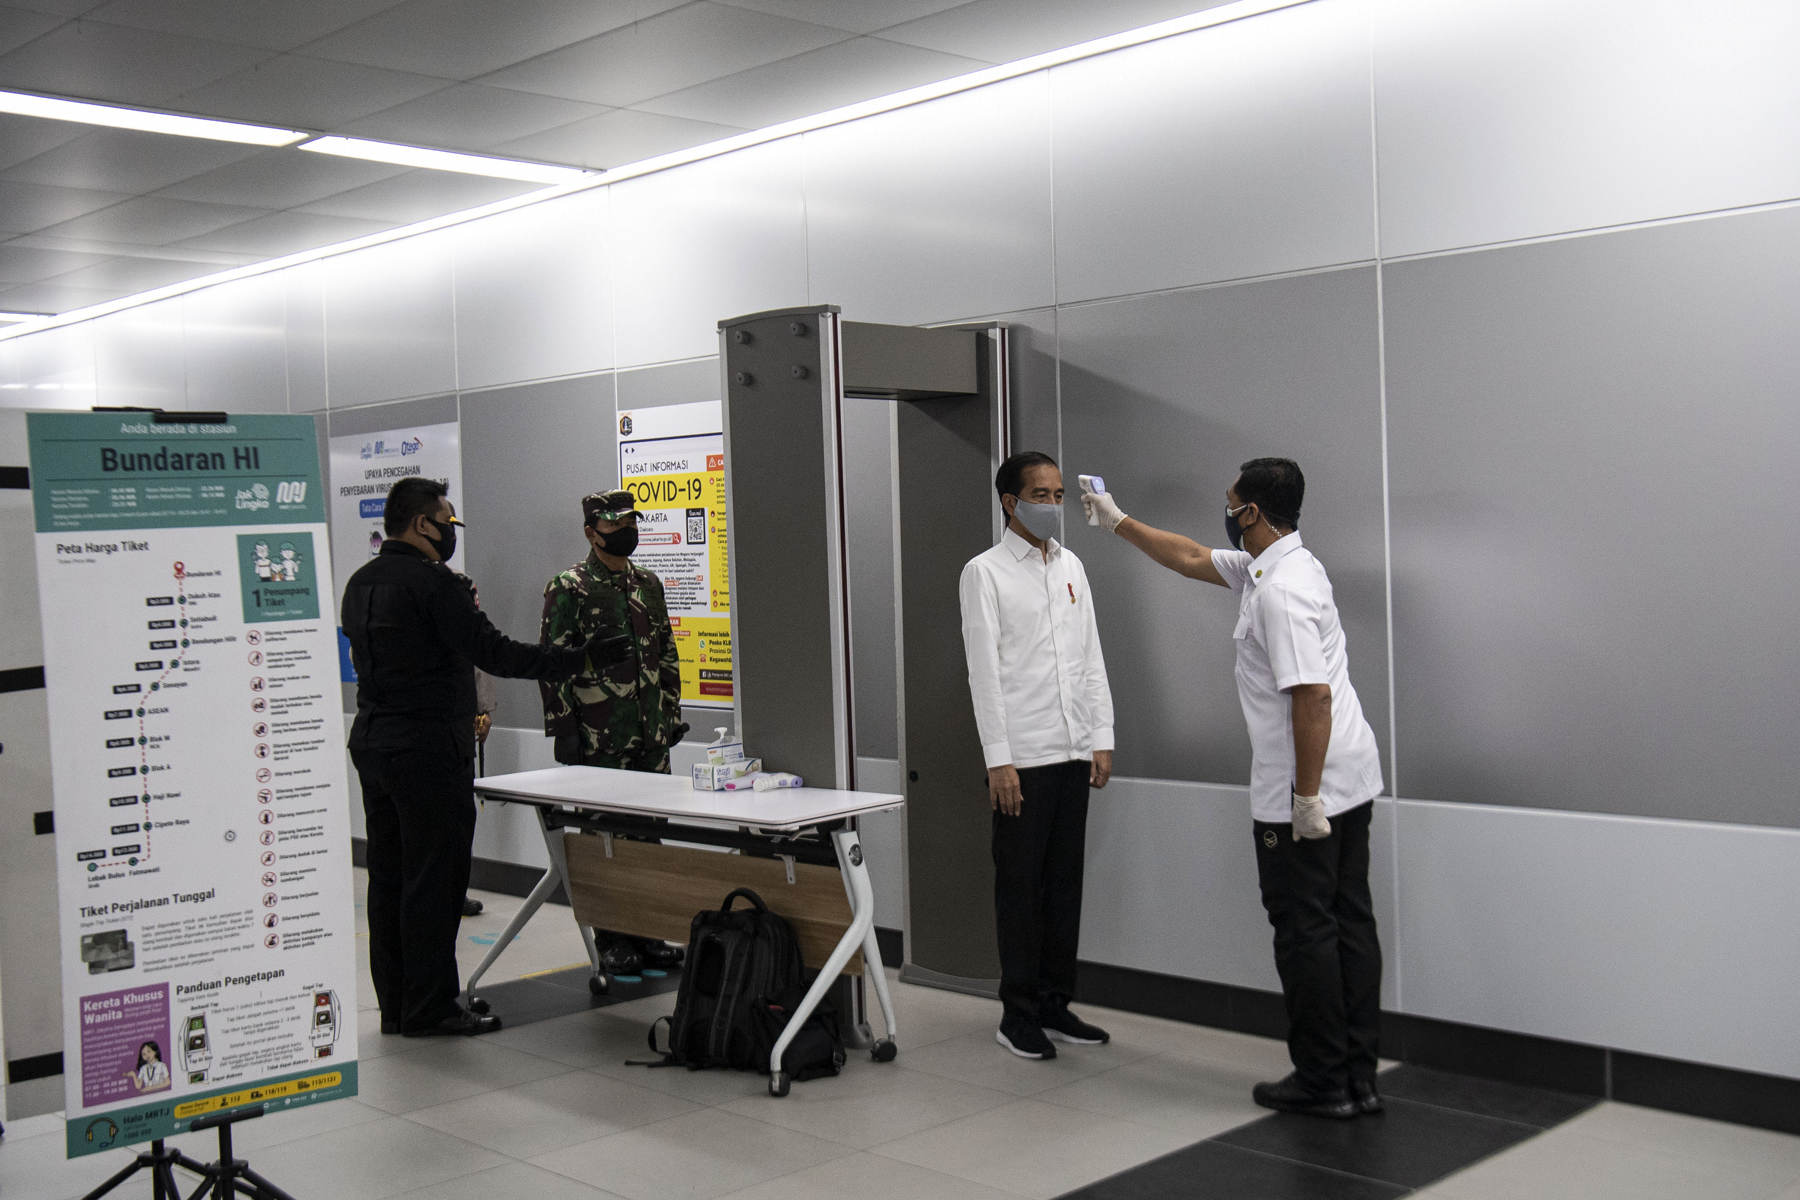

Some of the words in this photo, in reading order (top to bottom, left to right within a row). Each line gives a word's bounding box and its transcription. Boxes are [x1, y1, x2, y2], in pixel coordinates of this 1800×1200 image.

[120, 423, 148, 434] Anda
[150, 424, 186, 434] berada
[188, 424, 198, 434] di
[200, 425, 238, 434] stasiun
[101, 446, 226, 472] Bundaran
[232, 446, 260, 470] HI
[626, 463, 648, 474] PUSAT
[650, 460, 688, 472] INFORMASI
[364, 469, 383, 480] UPAYA
[383, 466, 421, 478] PENCEGAHAN
[340, 484, 376, 496] PENYEBARAN
[376, 482, 392, 493] VIRUS
[626, 478, 702, 502] COVID-19
[56, 543, 82, 554] Peta
[85, 542, 118, 554] Harga
[120, 540, 150, 552] Tiket
[252, 588, 262, 608] 1
[80, 905, 109, 918] Tiket
[112, 897, 170, 913] Perjalanan
[172, 888, 216, 904] Tunggal
[176, 980, 222, 996] Panduan
[224, 968, 286, 988] Pengetapan
[84, 998, 120, 1012] Kereta
[123, 990, 164, 1006] Khusus
[84, 1010, 122, 1025] Wanita
